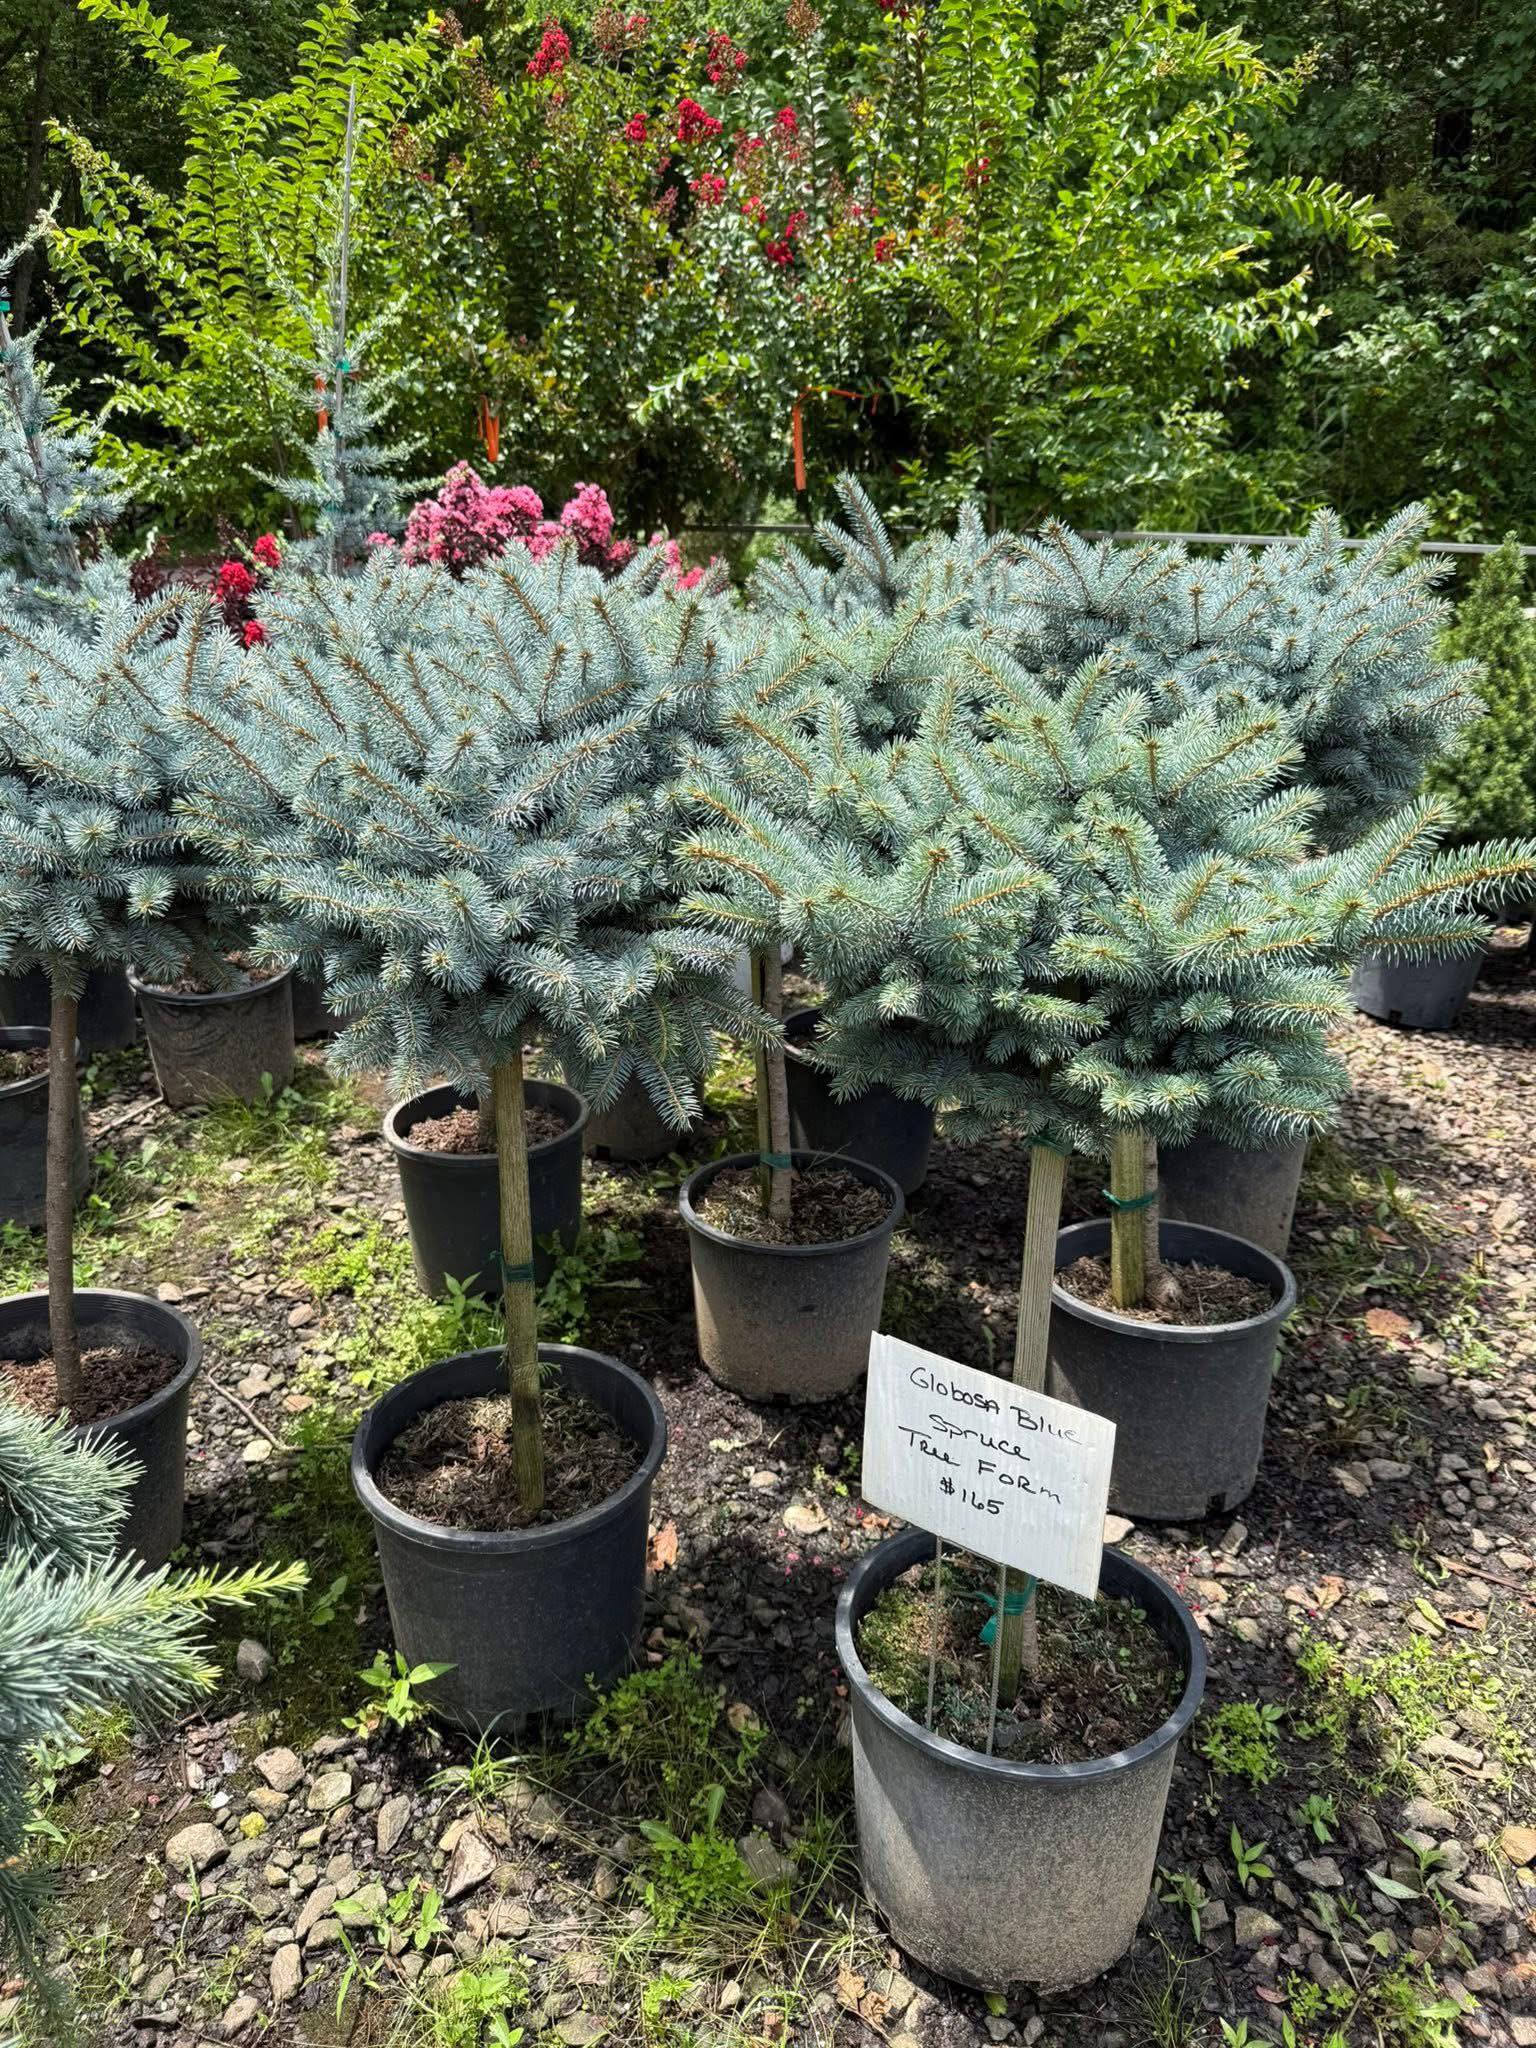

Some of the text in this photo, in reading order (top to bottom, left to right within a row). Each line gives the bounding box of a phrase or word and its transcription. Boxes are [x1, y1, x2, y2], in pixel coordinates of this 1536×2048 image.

[929, 1414, 1030, 1461] Spruce
[1010, 1406, 1082, 1445] Blue
[940, 1477, 1005, 1515] $165
